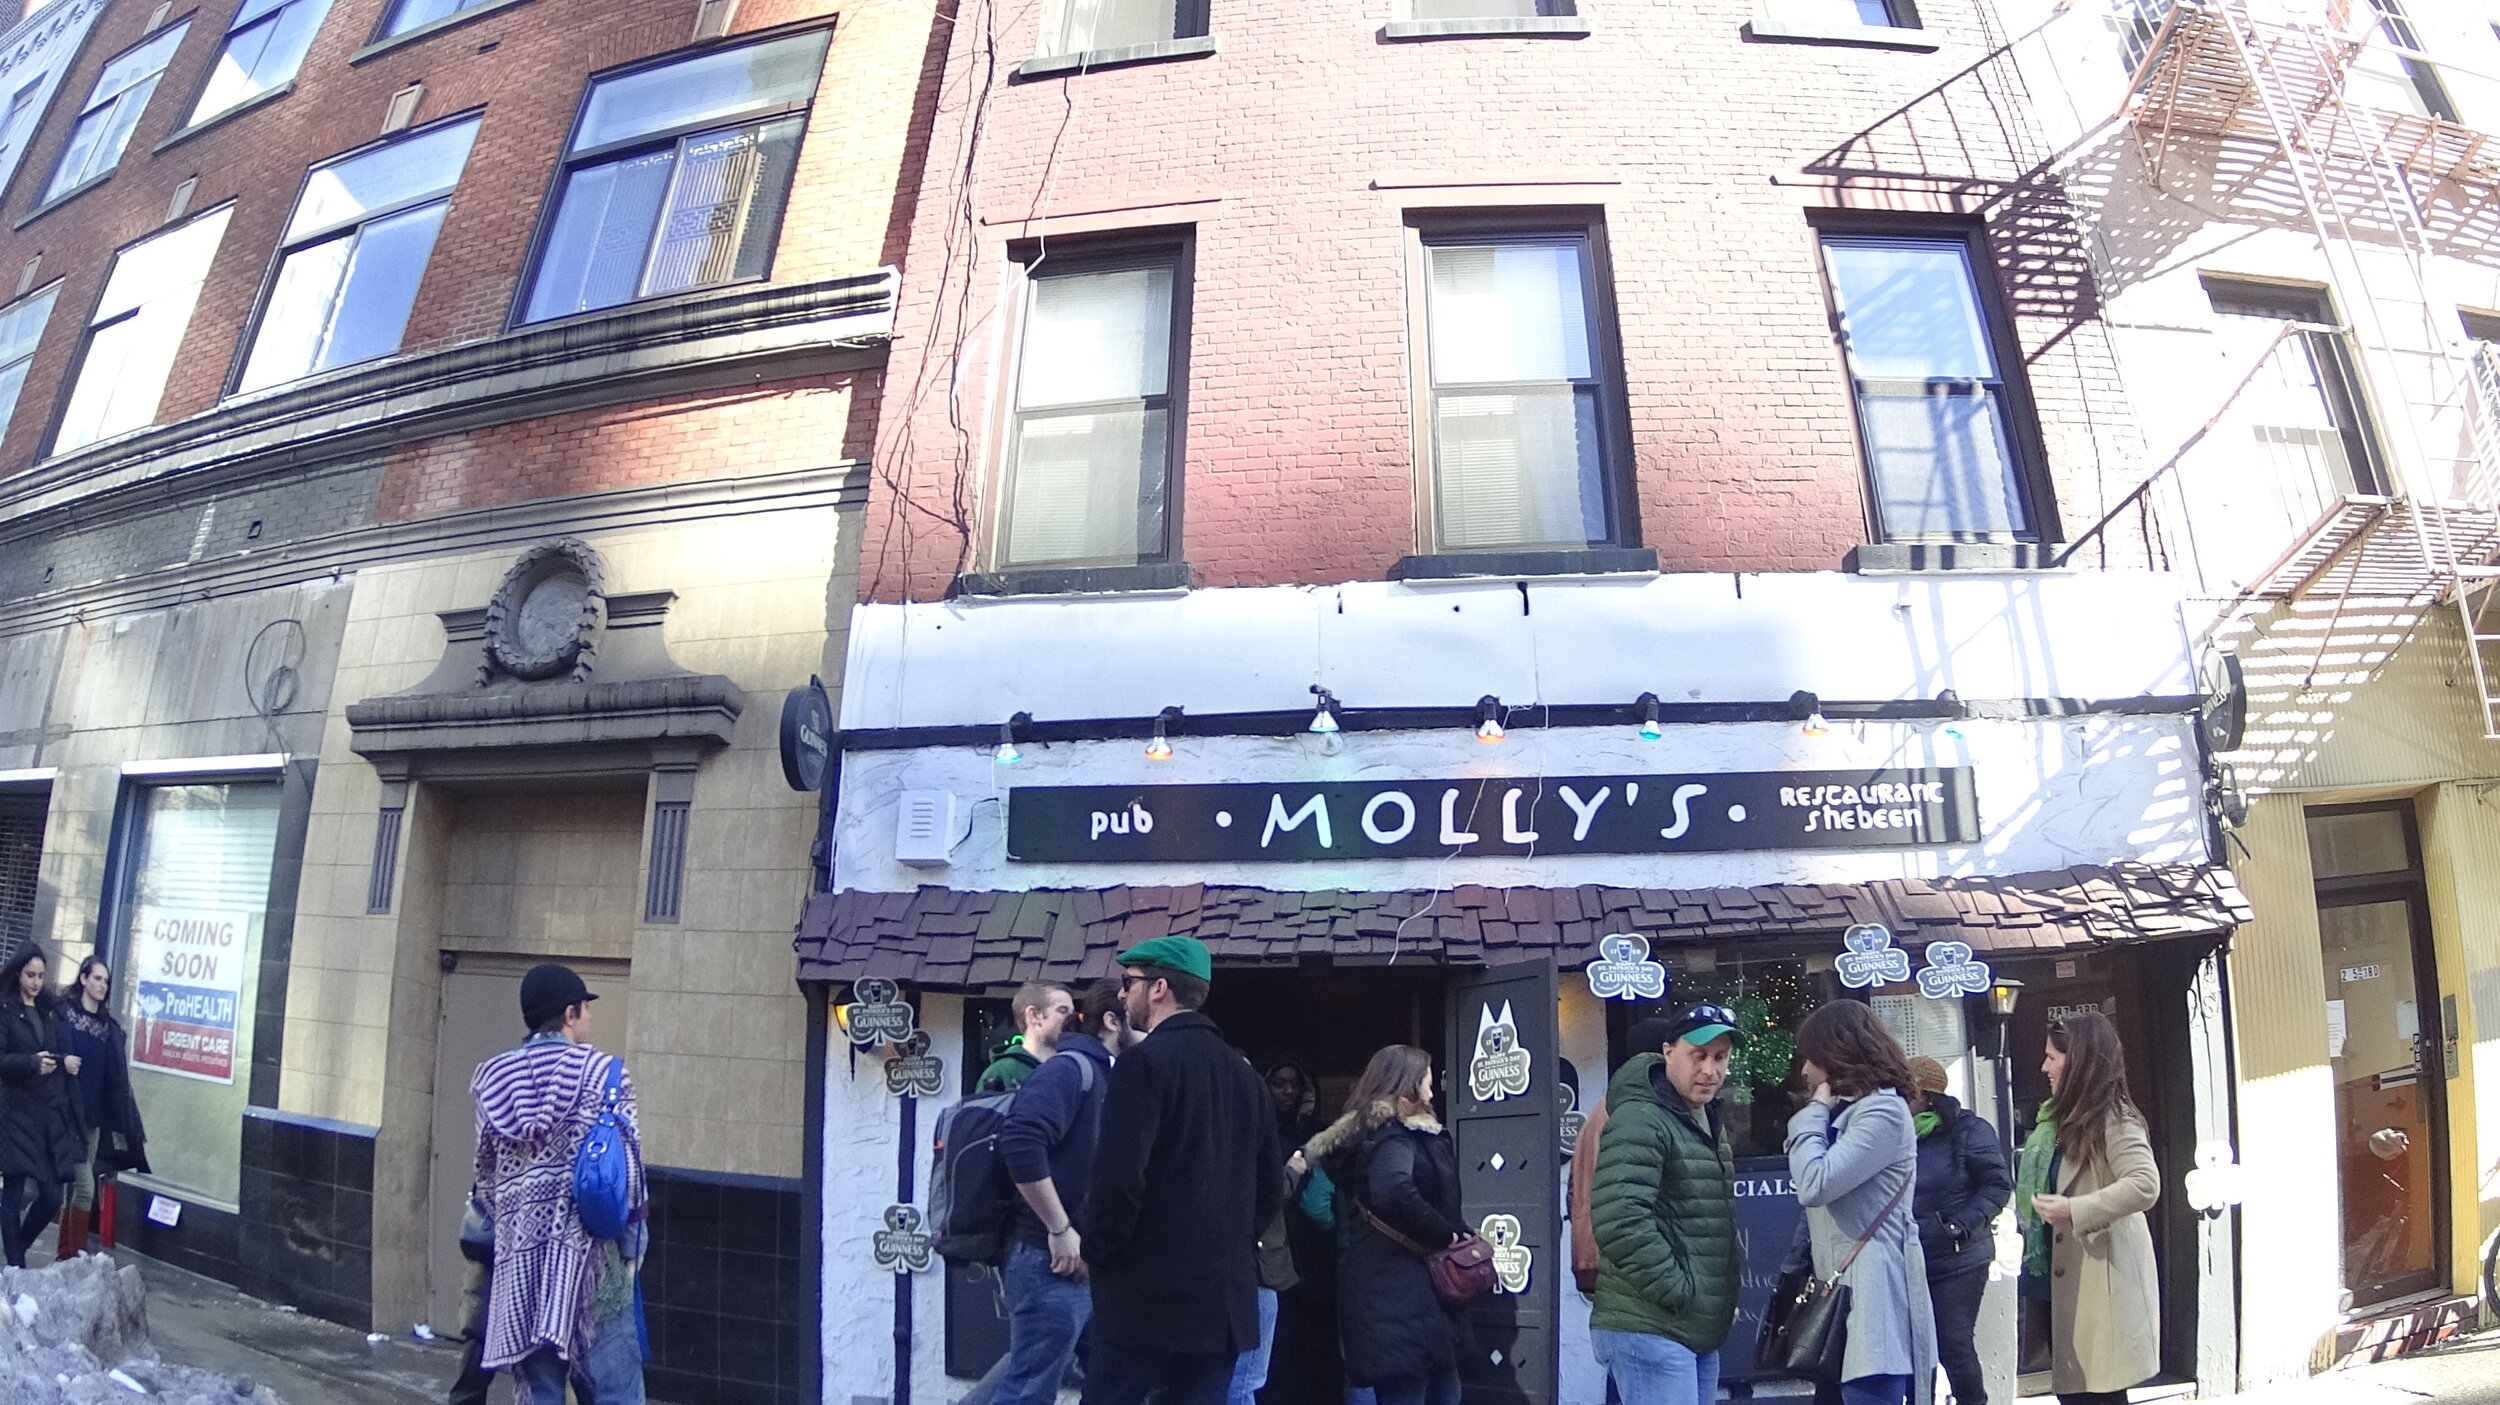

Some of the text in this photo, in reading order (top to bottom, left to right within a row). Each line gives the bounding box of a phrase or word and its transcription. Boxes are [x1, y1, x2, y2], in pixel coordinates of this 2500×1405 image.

[1090, 803, 1154, 840] pub
[1261, 782, 1707, 848] MOLLY'S
[155, 919, 234, 947] COMING
[162, 951, 218, 980] SOON
[1848, 960, 1900, 974] GUINNESS
[1600, 971, 1654, 983] GUINNESS
[1929, 973, 1980, 986] GUINNESS
[165, 992, 233, 1022] ProHEALTH
[854, 1015, 903, 1027] GUINNESS
[163, 1030, 201, 1050] URGENT
[202, 1036, 230, 1055] CARE
[891, 1068, 936, 1080] GUINNESS
[1478, 1065, 1520, 1082] GUINNESS
[1733, 1178, 1799, 1197] CIALS
[879, 1240, 924, 1256] GUINNESS
